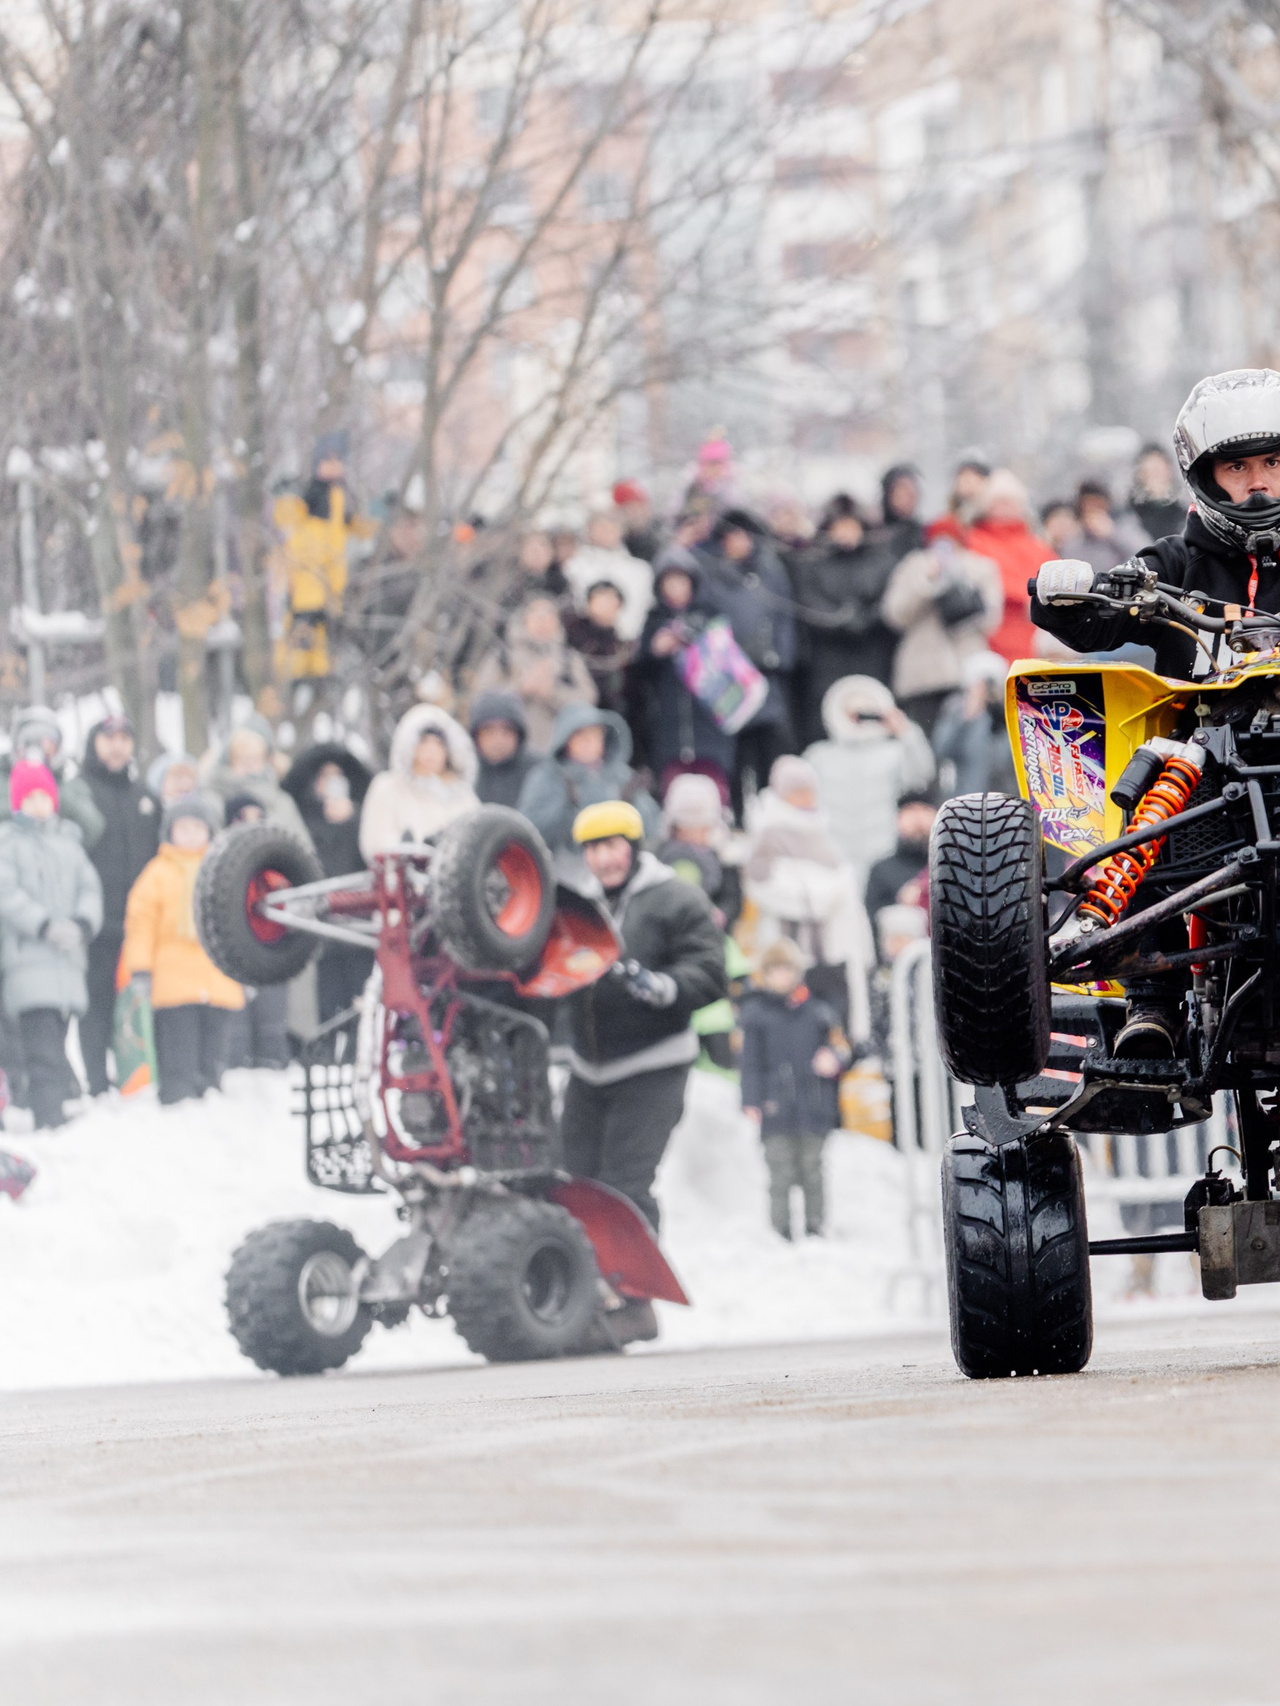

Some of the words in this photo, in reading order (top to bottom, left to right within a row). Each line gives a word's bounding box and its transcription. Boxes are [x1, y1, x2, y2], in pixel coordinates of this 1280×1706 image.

[1031, 682, 1072, 690] GoPro
[1041, 701, 1071, 731] VP
[1022, 714, 1042, 794] FASTHOUSE
[1049, 740, 1065, 797] AMSOIL
[1039, 808, 1070, 822] FOX
